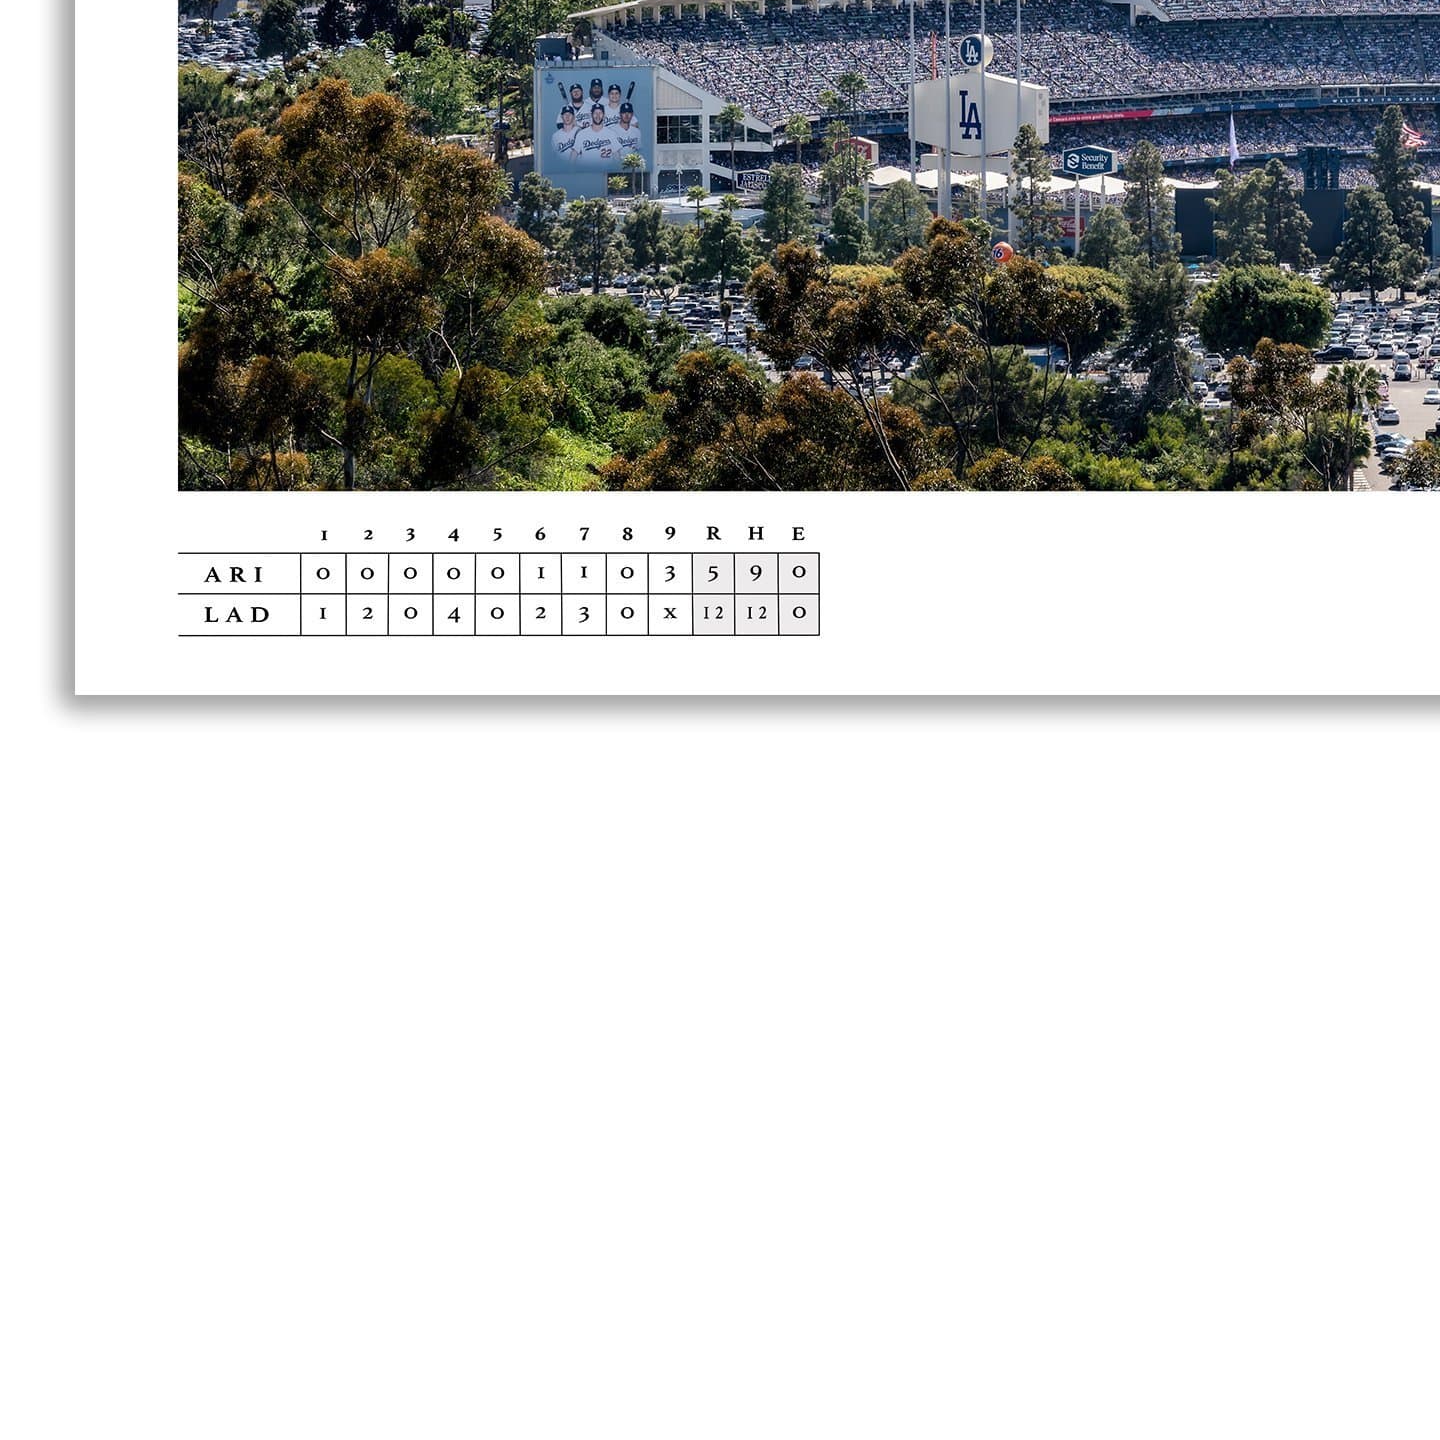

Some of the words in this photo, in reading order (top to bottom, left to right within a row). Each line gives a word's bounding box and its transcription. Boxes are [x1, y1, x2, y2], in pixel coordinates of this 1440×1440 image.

[965, 40, 979, 63] LA
[959, 90, 982, 140] LA
[600, 148, 612, 158] 22
[1081, 153, 1108, 164] Security
[1081, 162, 1105, 170] Benefit
[320, 529, 328, 541] 1
[363, 529, 374, 541] 2
[405, 527, 416, 543] 3
[447, 527, 460, 543] 4
[493, 527, 503, 542] 5
[534, 526, 546, 541] 6
[579, 527, 590, 542] 7
[622, 526, 634, 542] 8
[664, 526, 676, 541] 9
[706, 525, 722, 541] R
[747, 526, 765, 541] H
[791, 526, 806, 541] E
[203, 566, 263, 583] ARI
[316, 567, 330, 580] 0
[360, 567, 375, 580] 0
[403, 566, 418, 580] 0
[447, 567, 461, 580] 0
[490, 566, 505, 580] 0
[536, 566, 545, 579] 1
[579, 566, 588, 579] 1
[620, 566, 634, 580] 0
[665, 565, 676, 583] 3
[708, 565, 719, 583] 5
[749, 564, 762, 582] 9
[792, 565, 806, 579] 0
[203, 606, 270, 623] LAD
[318, 607, 327, 620] 1
[362, 607, 373, 620] 2
[404, 606, 418, 620] 0
[447, 607, 461, 623] 4
[490, 606, 505, 620] 0
[535, 606, 546, 619] 2
[579, 606, 590, 624] 3
[620, 606, 635, 620] 0
[663, 607, 677, 619] x
[702, 606, 724, 620] 12
[746, 606, 768, 620] 12
[792, 606, 807, 619] 0
